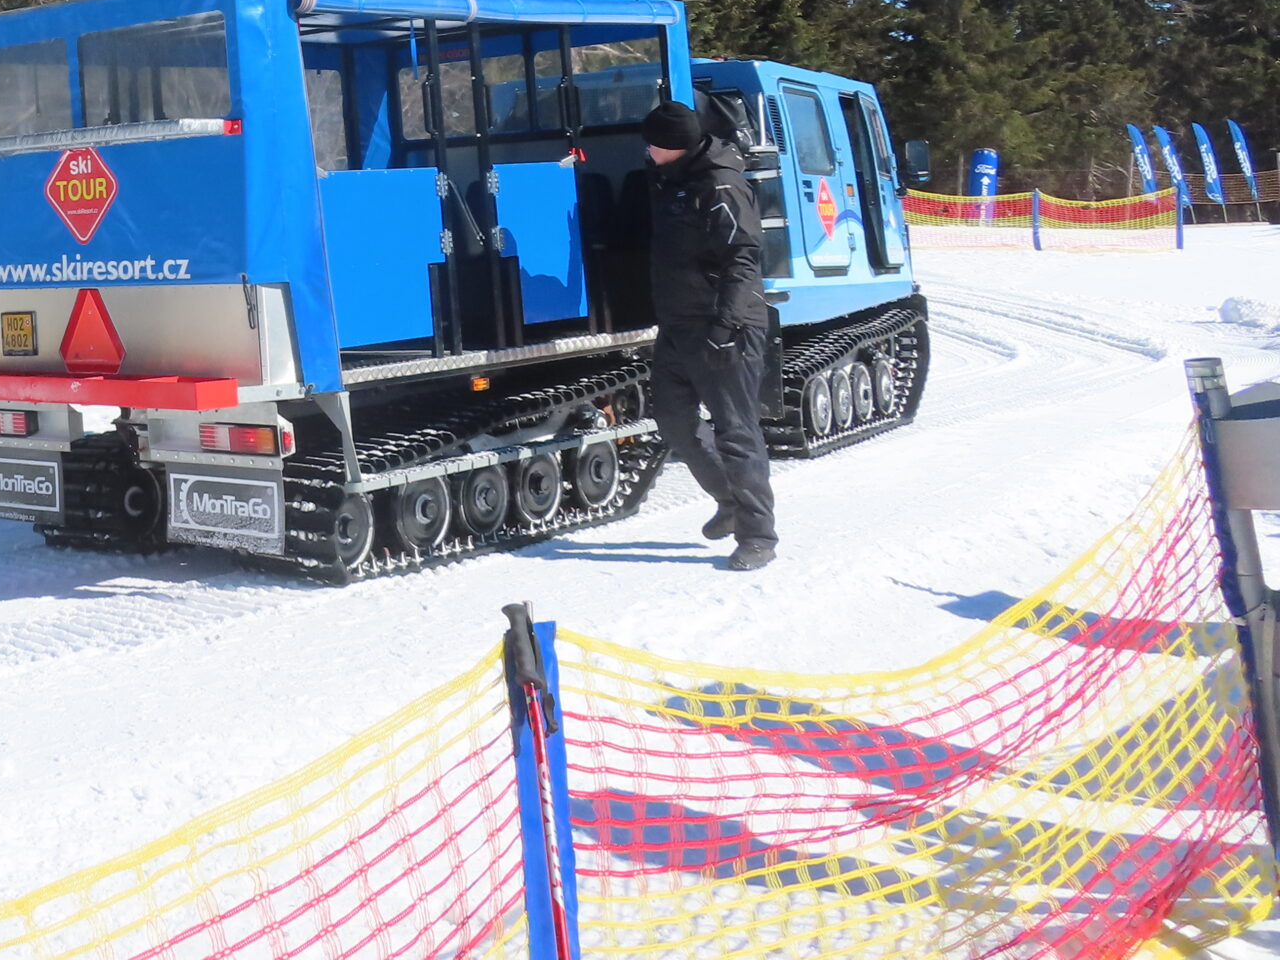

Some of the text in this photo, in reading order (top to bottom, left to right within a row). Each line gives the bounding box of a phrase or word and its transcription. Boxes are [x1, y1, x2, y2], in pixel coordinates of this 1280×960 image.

[69, 155, 92, 175] ski
[55, 178, 107, 201] TOUR
[192, 491, 271, 519] MonTraGo
